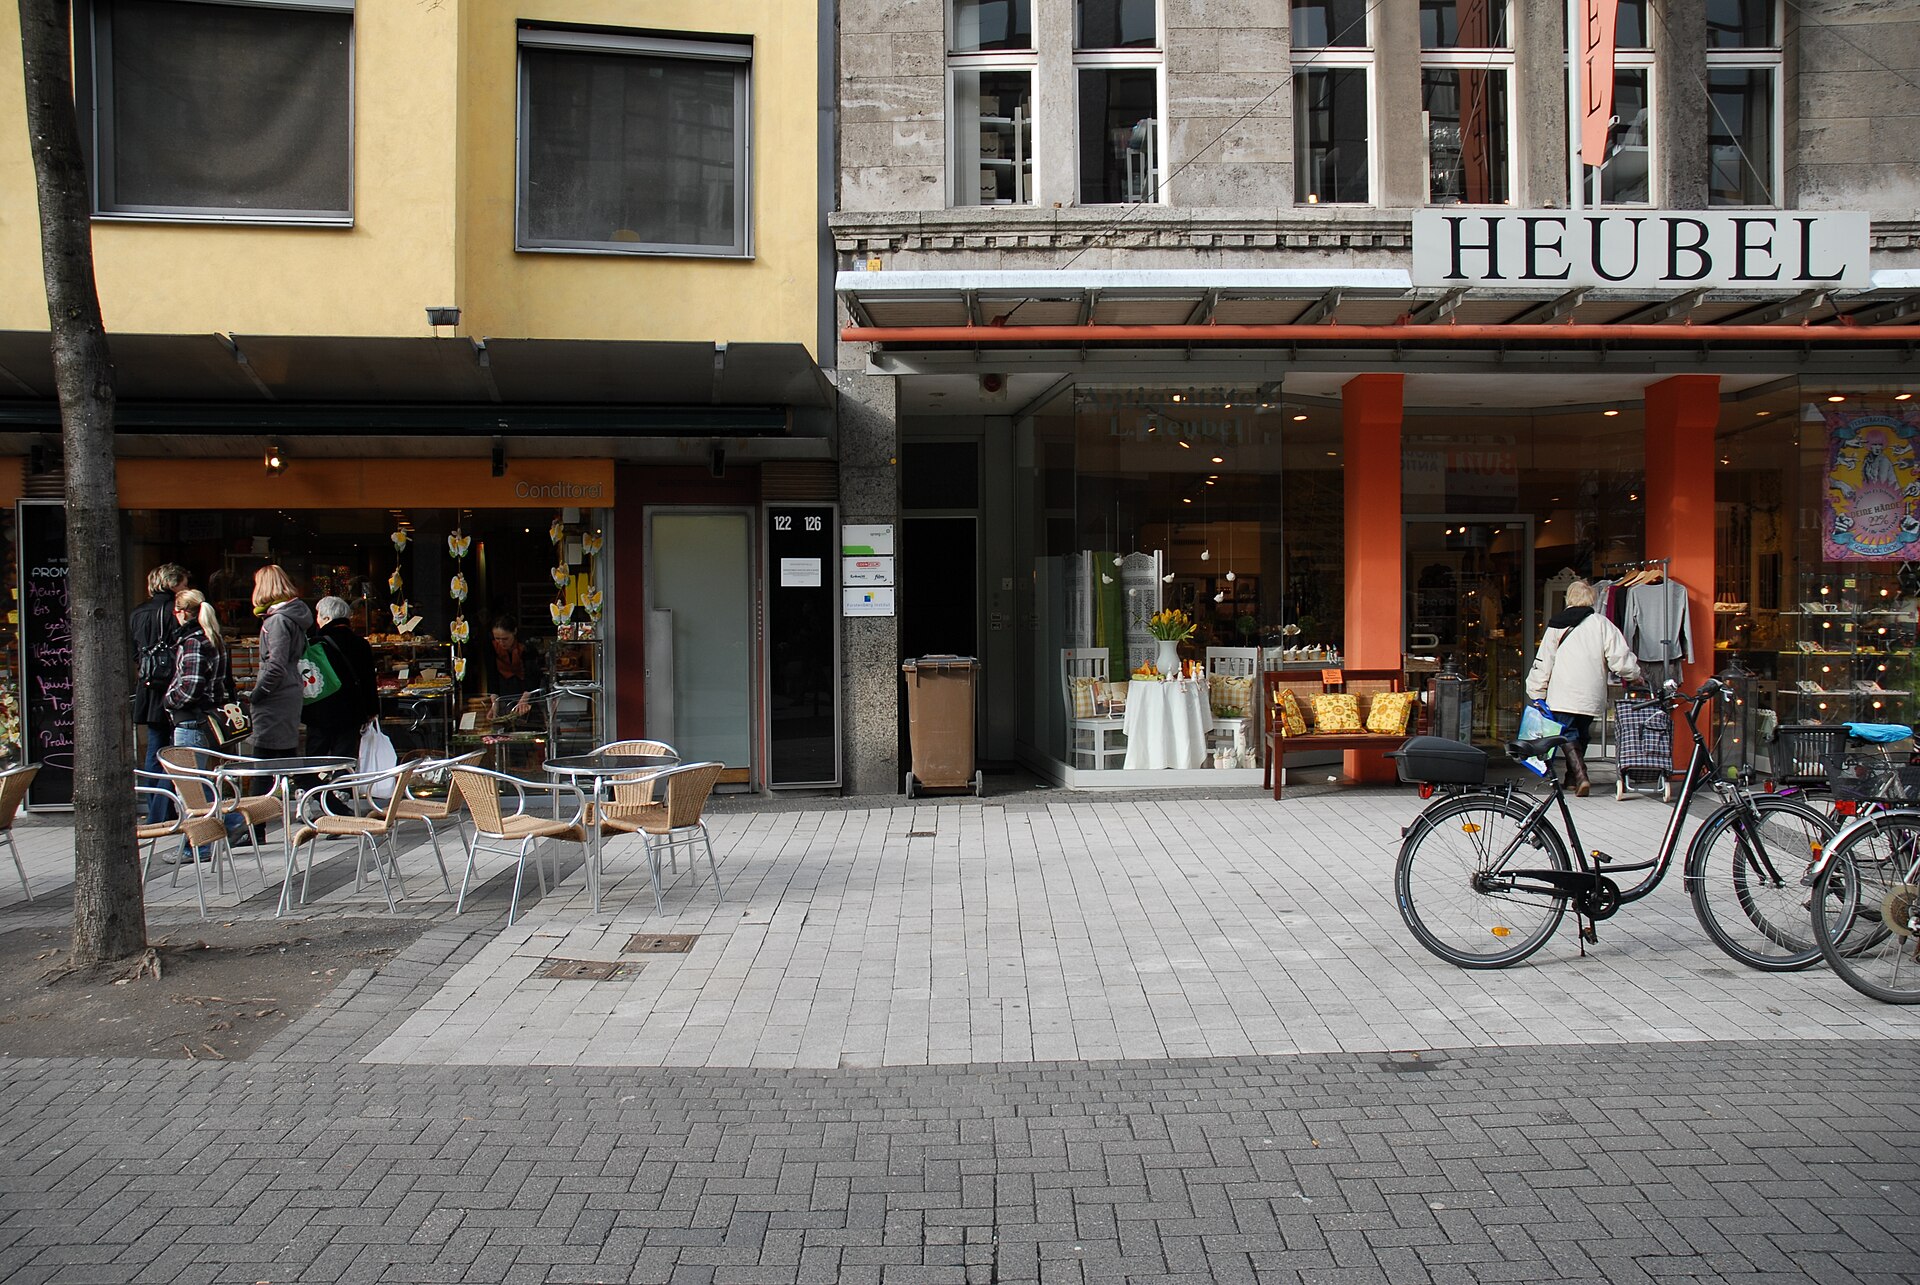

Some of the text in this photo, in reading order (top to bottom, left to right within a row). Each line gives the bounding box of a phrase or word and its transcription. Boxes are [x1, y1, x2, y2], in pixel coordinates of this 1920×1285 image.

[1442, 216, 1847, 282] HEUBEL
[515, 480, 604, 499] Conditorei
[774, 515, 822, 531] 122 126
